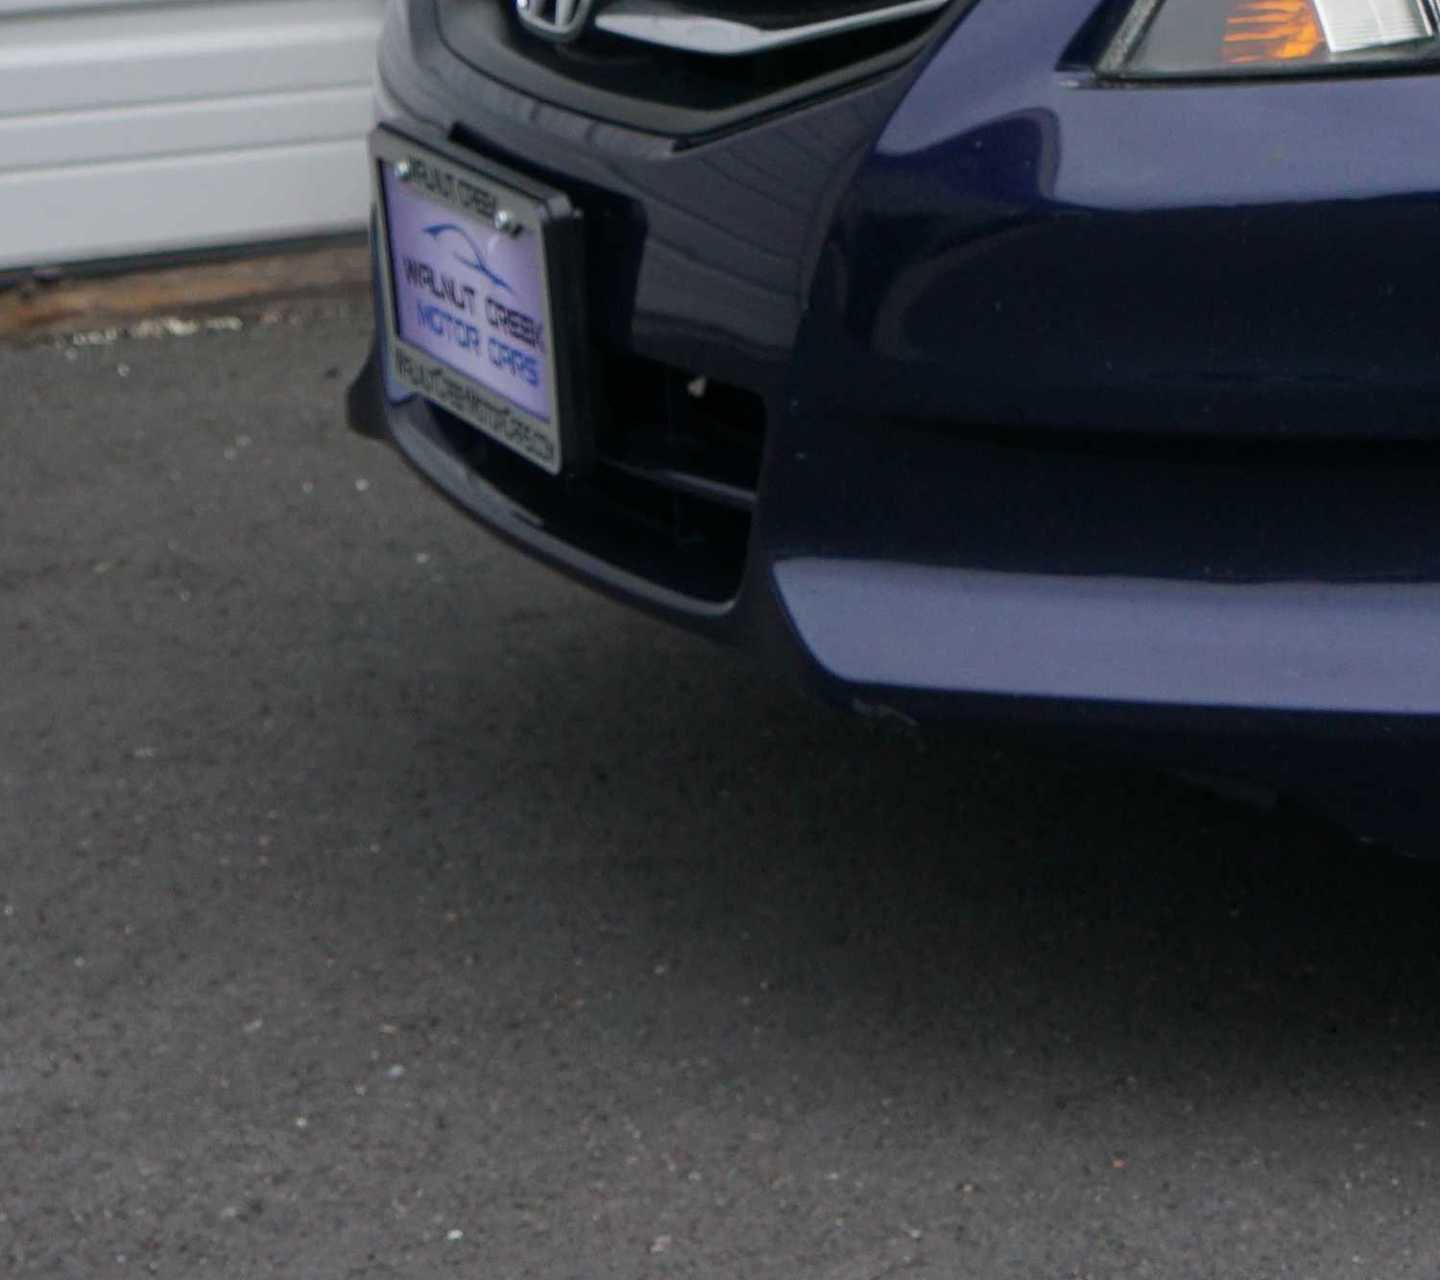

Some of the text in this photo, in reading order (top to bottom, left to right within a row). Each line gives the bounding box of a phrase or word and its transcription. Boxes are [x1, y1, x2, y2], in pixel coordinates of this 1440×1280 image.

[402, 255, 546, 354] WALNUT CREEK
[416, 299, 540, 388] MOTOR CARS
